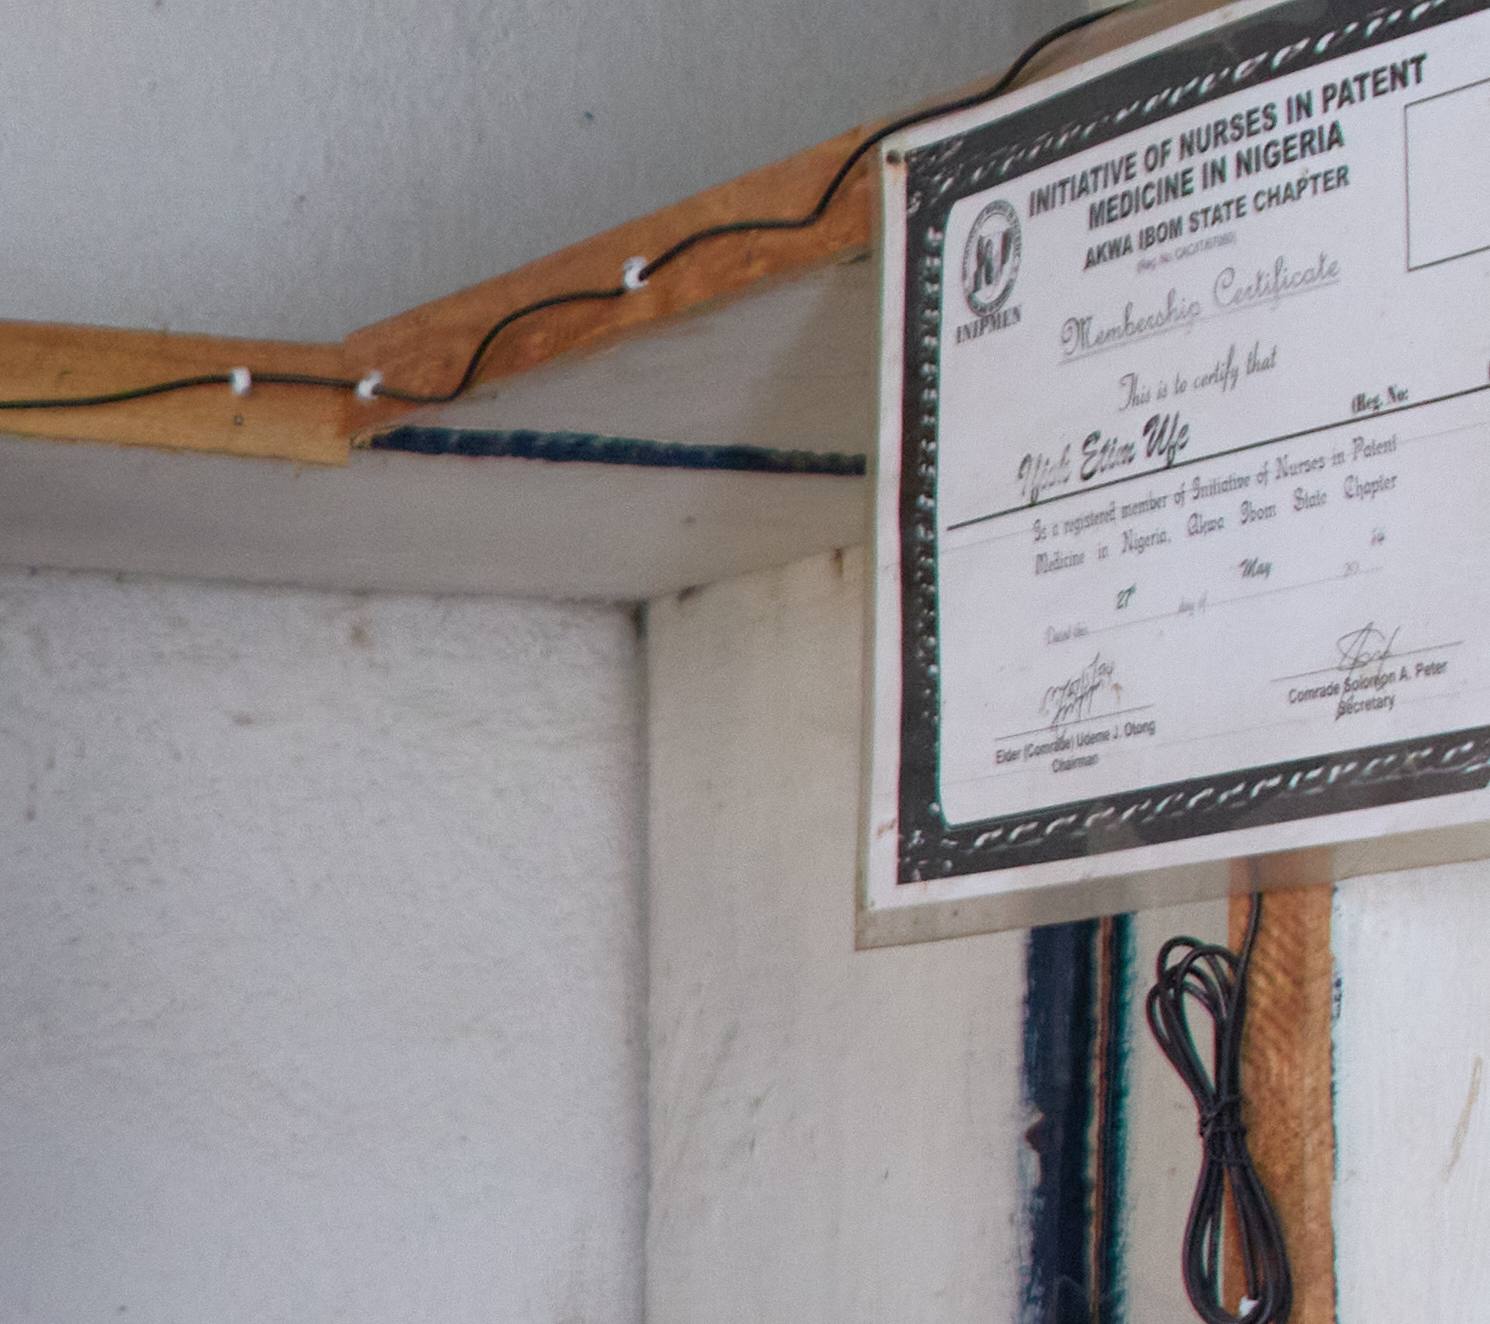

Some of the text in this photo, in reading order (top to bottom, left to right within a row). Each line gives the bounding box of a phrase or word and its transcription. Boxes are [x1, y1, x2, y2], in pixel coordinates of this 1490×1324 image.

[1029, 53, 1427, 217] INITIATIVE OF NURSES IN PATENT
[1089, 121, 1344, 230] MEDICINE IN NIGERIA
[1289, 683, 1339, 705] Comrade
[1415, 660, 1448, 679] Peter
